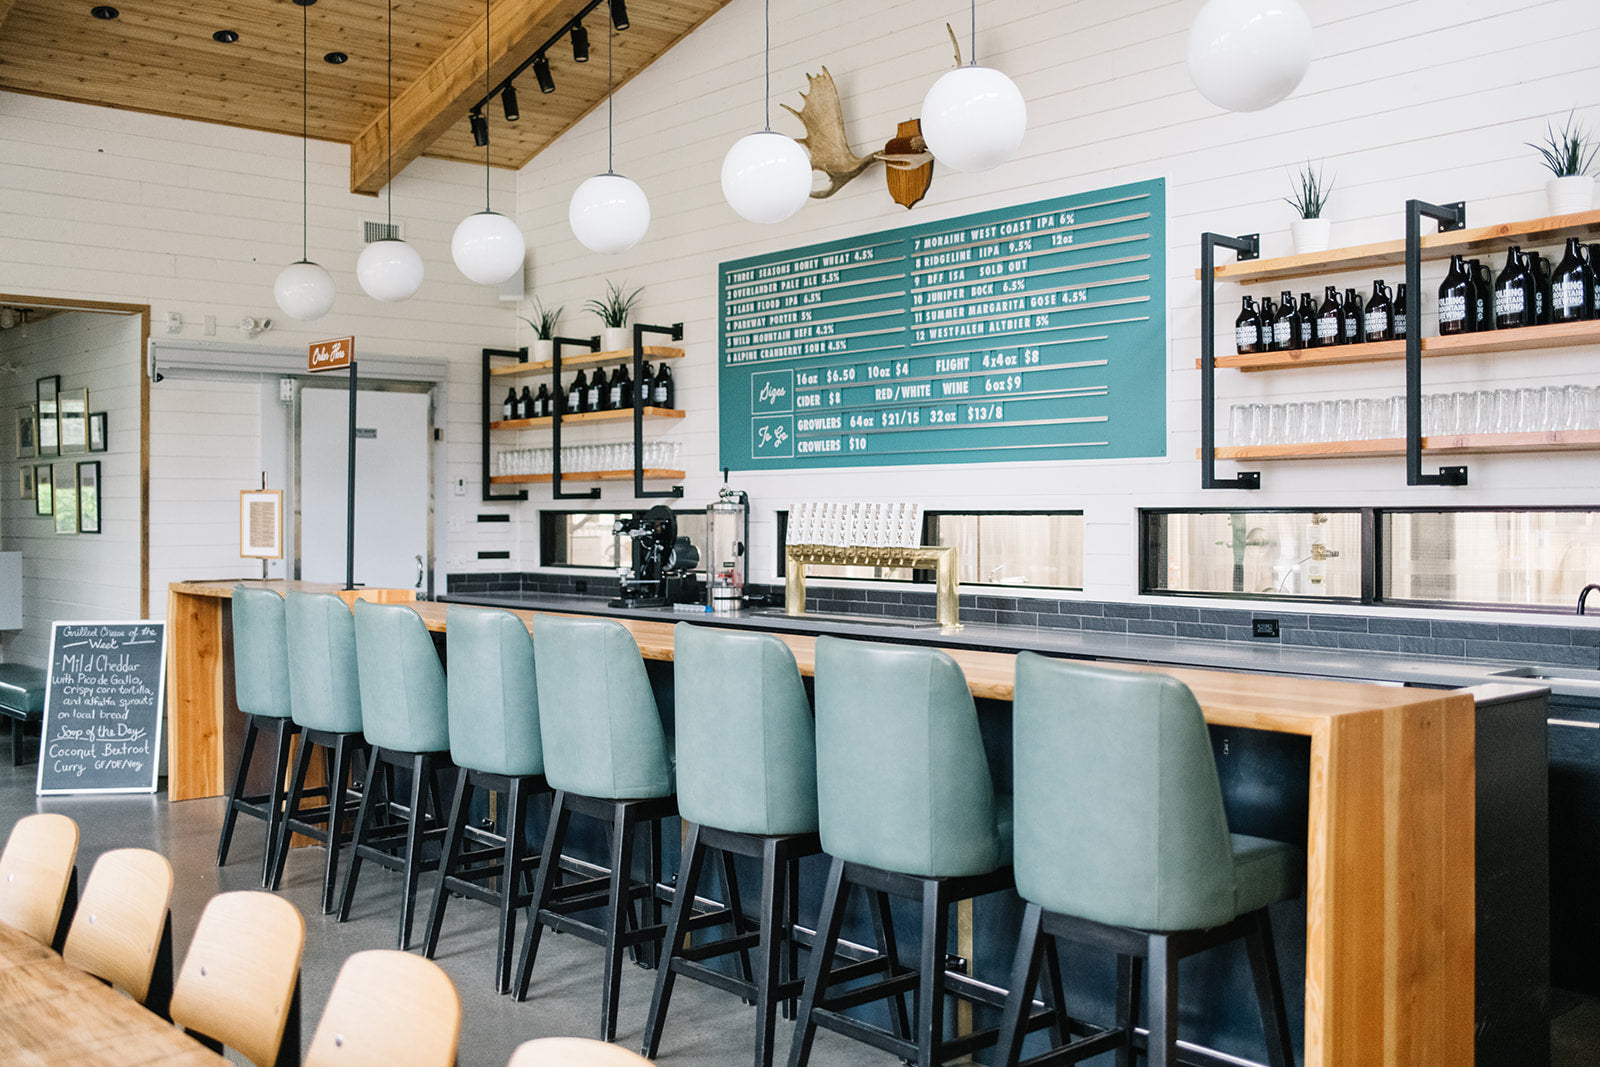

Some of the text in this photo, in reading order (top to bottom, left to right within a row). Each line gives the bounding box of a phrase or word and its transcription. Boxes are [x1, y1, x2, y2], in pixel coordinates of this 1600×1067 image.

[915, 213, 1075, 250] 7 MORAINE WEST COAST IPA 6%
[915, 235, 1073, 268] 8 RIDGELINE IIPA 9.5% 12oz
[727, 249, 873, 284] 1 THREE SEASONS HONEY WHEAT 4.5%
[914, 260, 1027, 286] 9 BFF ISA SOLD OUT
[727, 272, 839, 300] 2 OVERLANDER PALE ALE 5.5%
[914, 280, 1025, 305] 10 JUNIPER BOCK 6.5%
[727, 292, 821, 315] 3 FLASH FLOOD IPA 6.5%
[915, 290, 1086, 323] 11 SUMMER MARGARITA GOSE 4.5%
[726, 311, 812, 331] 4 PARKWAY PORTER 5%
[916, 315, 1049, 341] 12 WESTFALEN ALTBIER 5%
[727, 324, 834, 347] 5 WILD MOUNTAIN HEFE 4.2%
[727, 340, 846, 363] 6 ALPINE CRANBERRY SOUR 4.5%
[797, 373, 818, 385] 16oz
[827, 368, 855, 384] $6.50
[868, 366, 890, 379] 10oz
[896, 362, 909, 377] $4
[936, 357, 970, 372] FLIGHT
[1025, 349, 1039, 365] $8
[759, 382, 786, 405] Sizes
[797, 394, 821, 407] CIDER
[829, 392, 841, 405] $8
[943, 381, 969, 395] WINE
[797, 404, 1003, 431] GROWLERS 64oz $21/15 32oz $13/8
[758, 425, 789, 448] To Go
[797, 437, 867, 453] CROWLERS $10
[62, 626, 97, 637] Grilled
[128, 627, 139, 642] of
[141, 627, 157, 636] the
[89, 638, 119, 649] Week
[96, 654, 140, 672] Cheddar
[52, 673, 74, 685] with
[78, 673, 96, 683] Pico
[97, 674, 108, 685] de
[58, 709, 129, 720] on local bread
[63, 696, 153, 710] and alfalfa sprouts
[57, 723, 144, 742] Soup of the Day
[49, 744, 96, 759] Coconut
[54, 760, 86, 777] Curry
